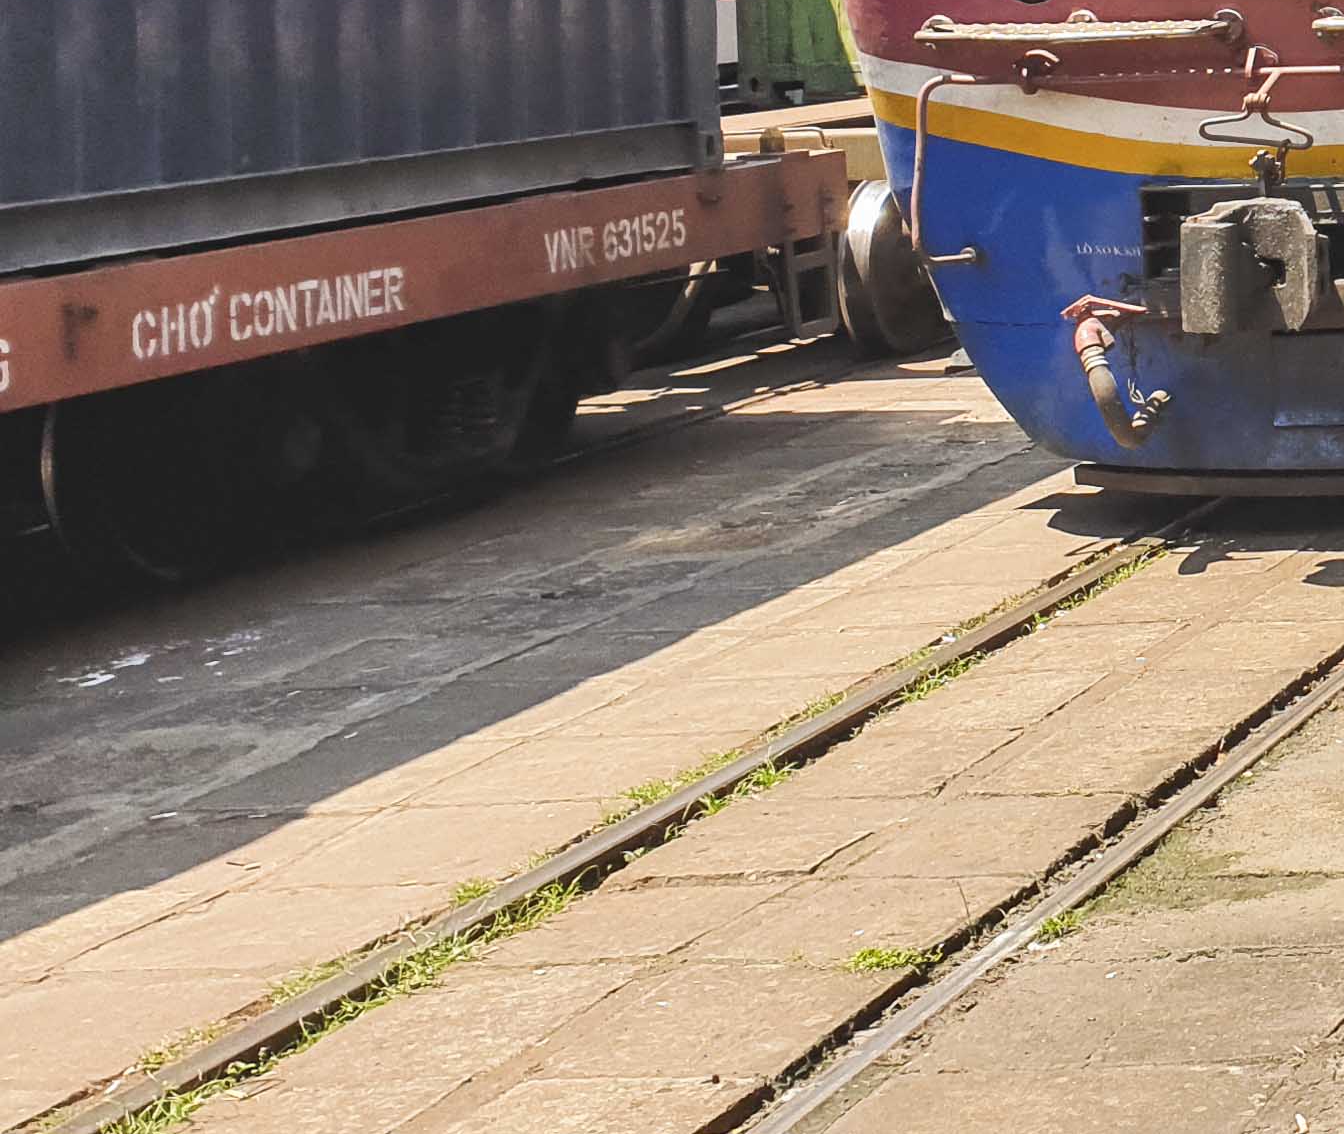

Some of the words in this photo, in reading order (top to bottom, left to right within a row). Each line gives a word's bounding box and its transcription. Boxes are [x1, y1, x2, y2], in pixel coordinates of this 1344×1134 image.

[544, 226, 595, 273] VNR
[603, 209, 686, 262] 631525
[229, 267, 404, 342] CONTAINER
